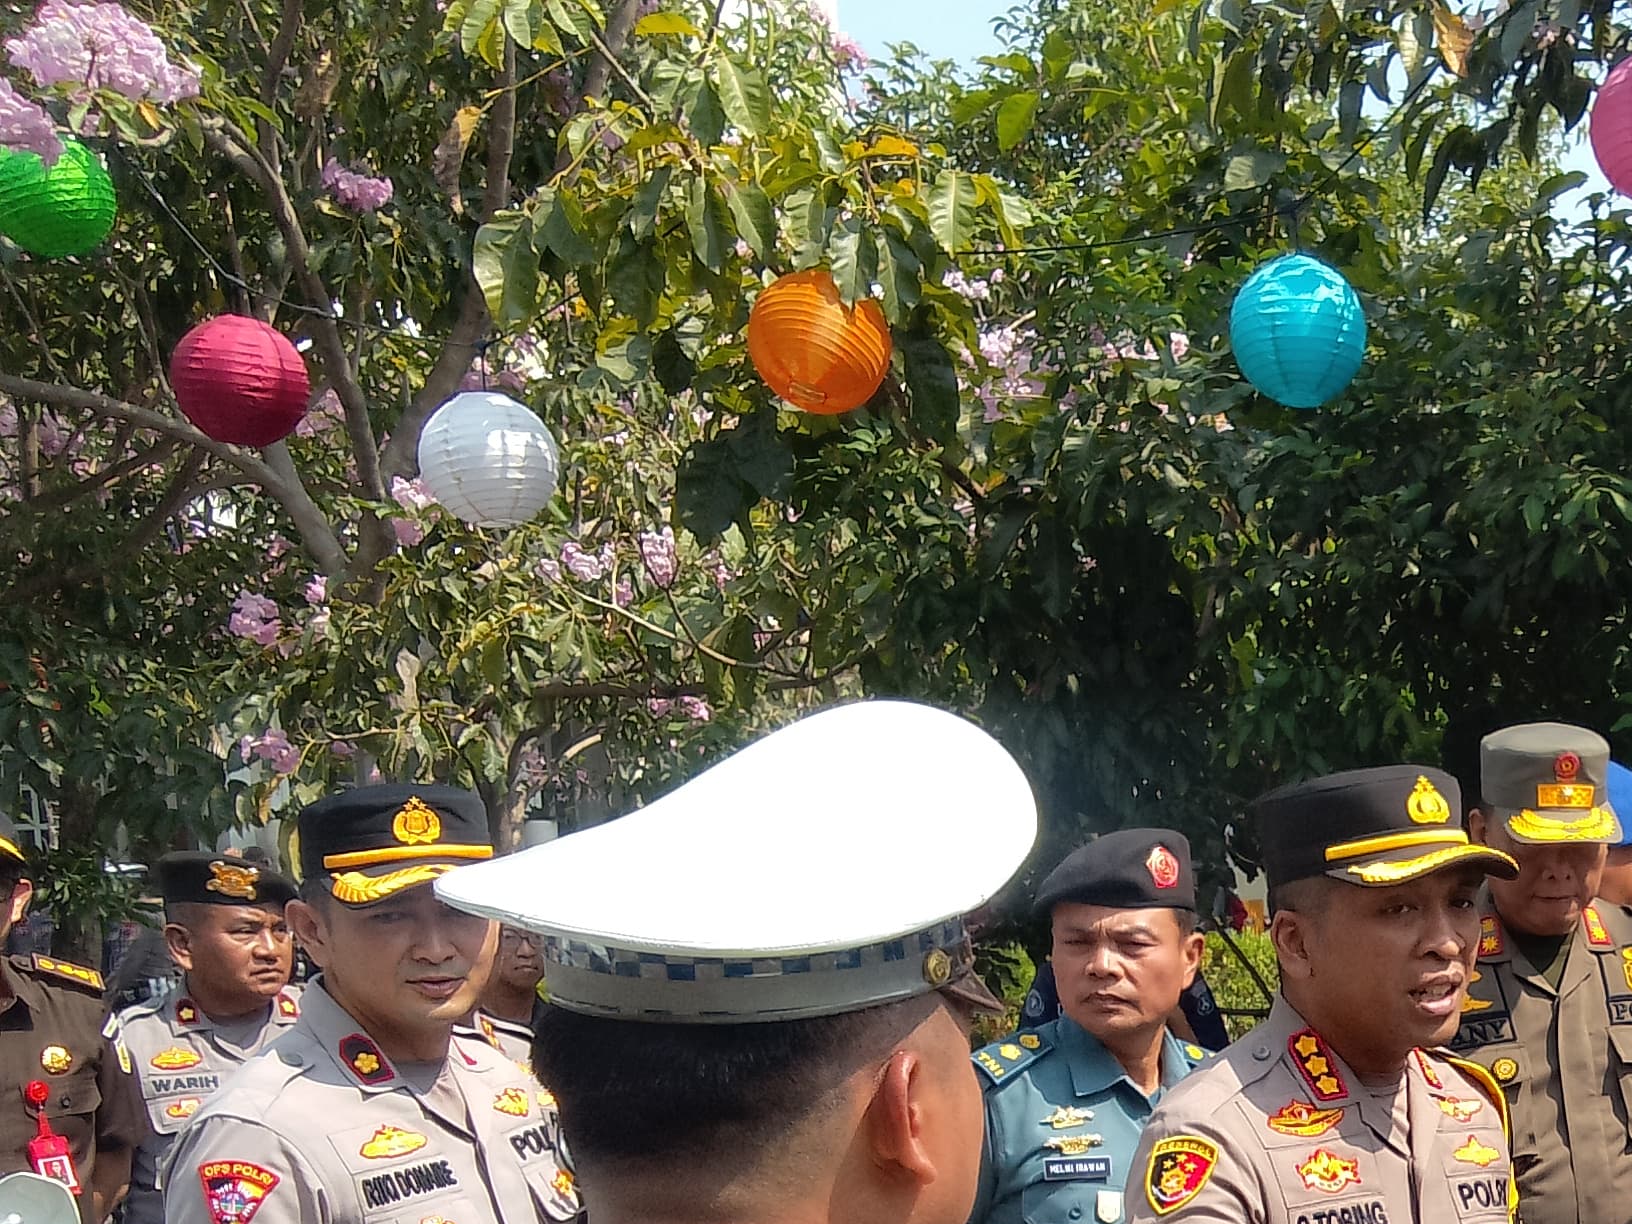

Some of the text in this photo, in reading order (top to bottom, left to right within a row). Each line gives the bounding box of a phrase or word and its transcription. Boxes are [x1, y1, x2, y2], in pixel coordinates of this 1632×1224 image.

[978, 1051, 1005, 1077] TNI
[152, 1074, 220, 1093] WARIH
[509, 1125, 557, 1161] POL
[204, 1163, 231, 1177] OPS
